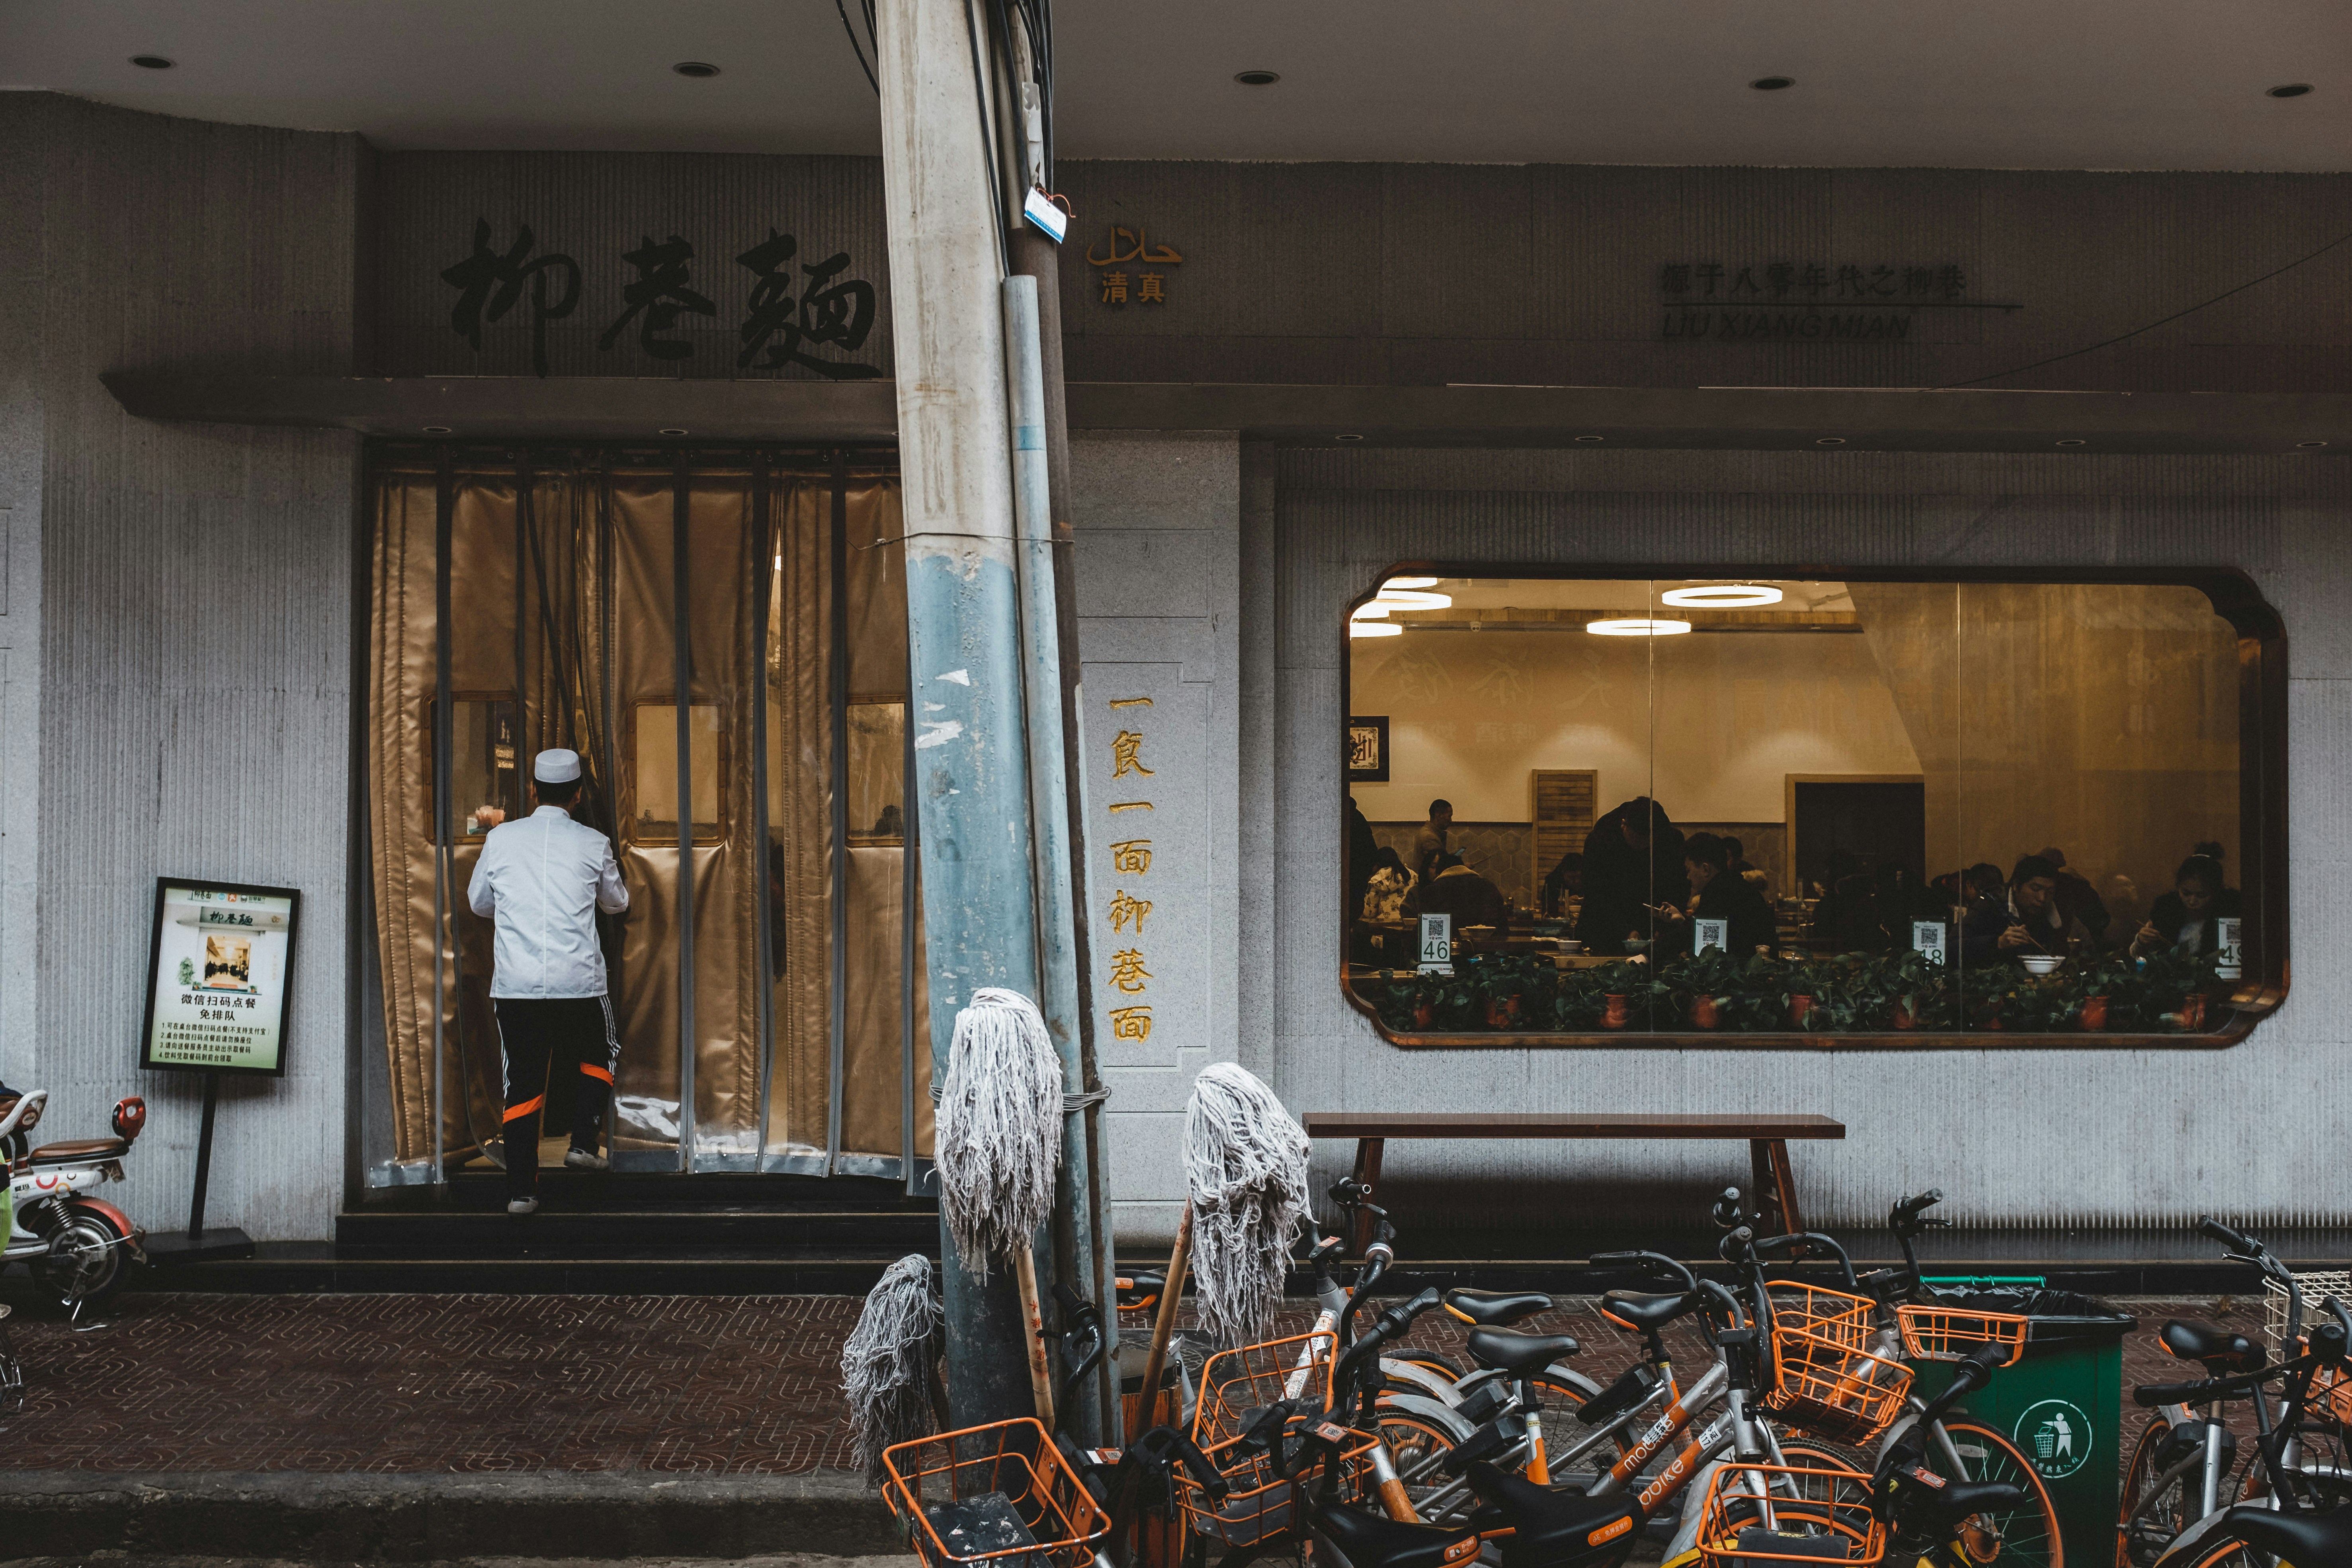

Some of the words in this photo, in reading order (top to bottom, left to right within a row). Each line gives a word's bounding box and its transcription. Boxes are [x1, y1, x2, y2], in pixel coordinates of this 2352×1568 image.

[1102, 271, 1165, 303] 清真
[1661, 262, 1966, 299] 源于八零年代之柳巷
[1662, 313, 1712, 338] LIU
[1717, 313, 1823, 338] XIANG
[1827, 314, 1912, 339] MIAN
[1424, 941, 1448, 959] 46
[181, 994, 256, 1009] 微信扫码点餐
[200, 1009, 235, 1021] 免排队
[1624, 1419, 1675, 1471] mobe
